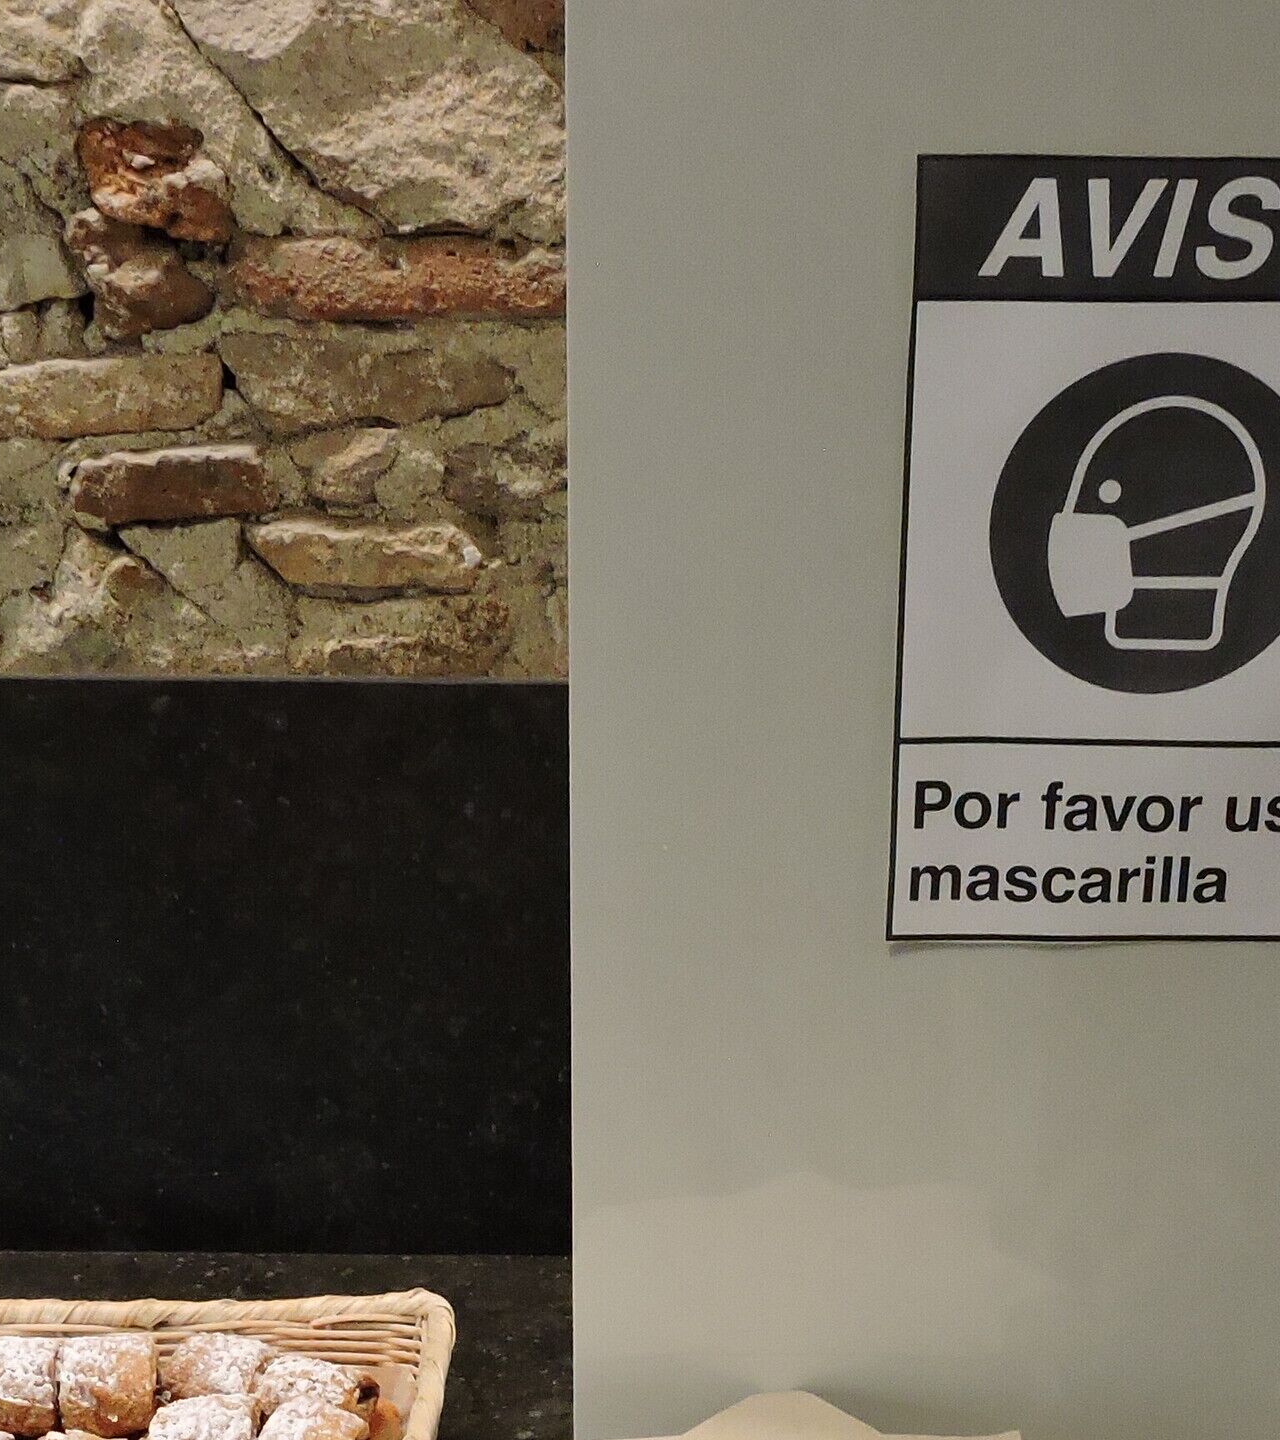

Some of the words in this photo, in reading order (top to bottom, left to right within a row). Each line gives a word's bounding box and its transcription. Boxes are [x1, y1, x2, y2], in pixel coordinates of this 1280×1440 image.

[913, 780, 1020, 830] Por
[1042, 782, 1201, 833] favor
[909, 856, 1228, 904] mascarilla
